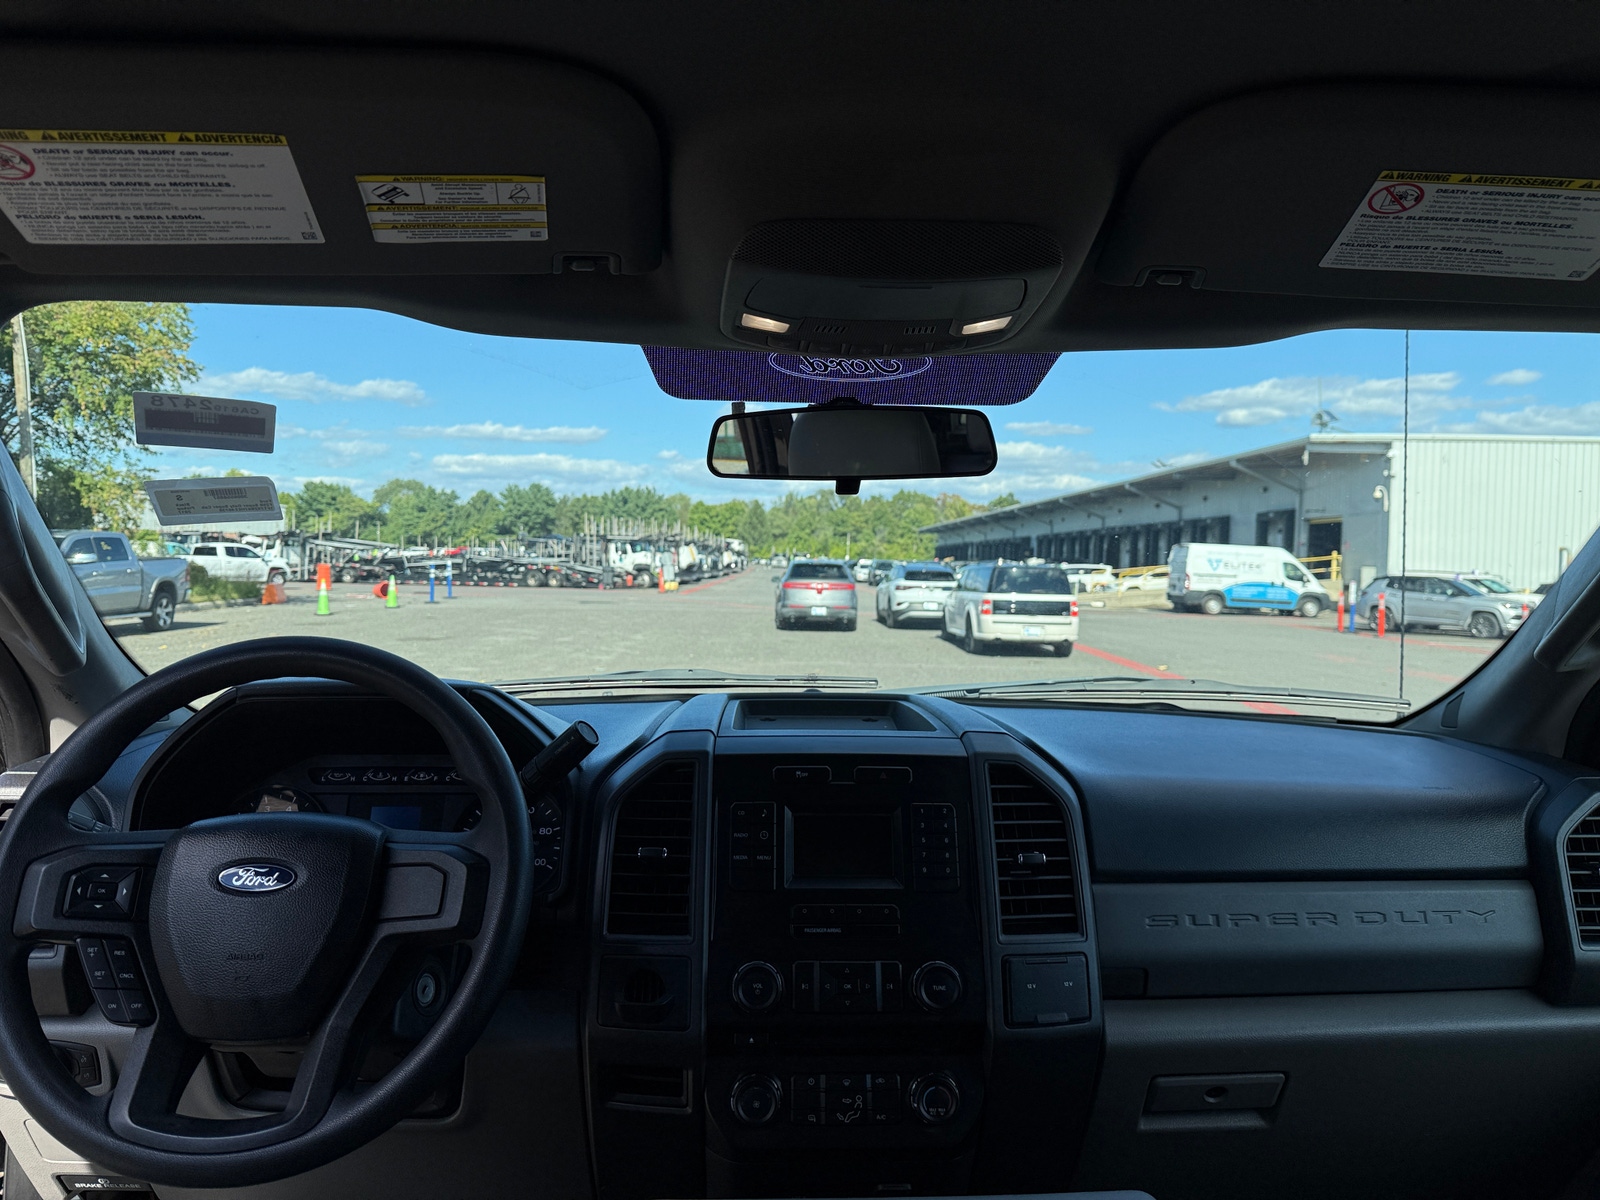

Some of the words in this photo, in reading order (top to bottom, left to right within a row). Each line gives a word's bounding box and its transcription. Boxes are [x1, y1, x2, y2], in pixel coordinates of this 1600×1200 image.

[0, 131, 29, 141] NING
[58, 131, 167, 142] AVERTISSEMENT
[195, 133, 283, 144] ADVERTENCIA
[1396, 172, 1452, 182] WARNING
[1473, 176, 1575, 187] AVERTISSEMENT
[1405, 215, 1462, 223] BLESSURES
[528, 806, 535, 814] 0
[538, 827, 552, 835] 80
[534, 858, 547, 866] 00
[232, 866, 280, 886] Ford
[1145, 911, 1338, 929] SUPER
[1353, 909, 1496, 927] DUTY
